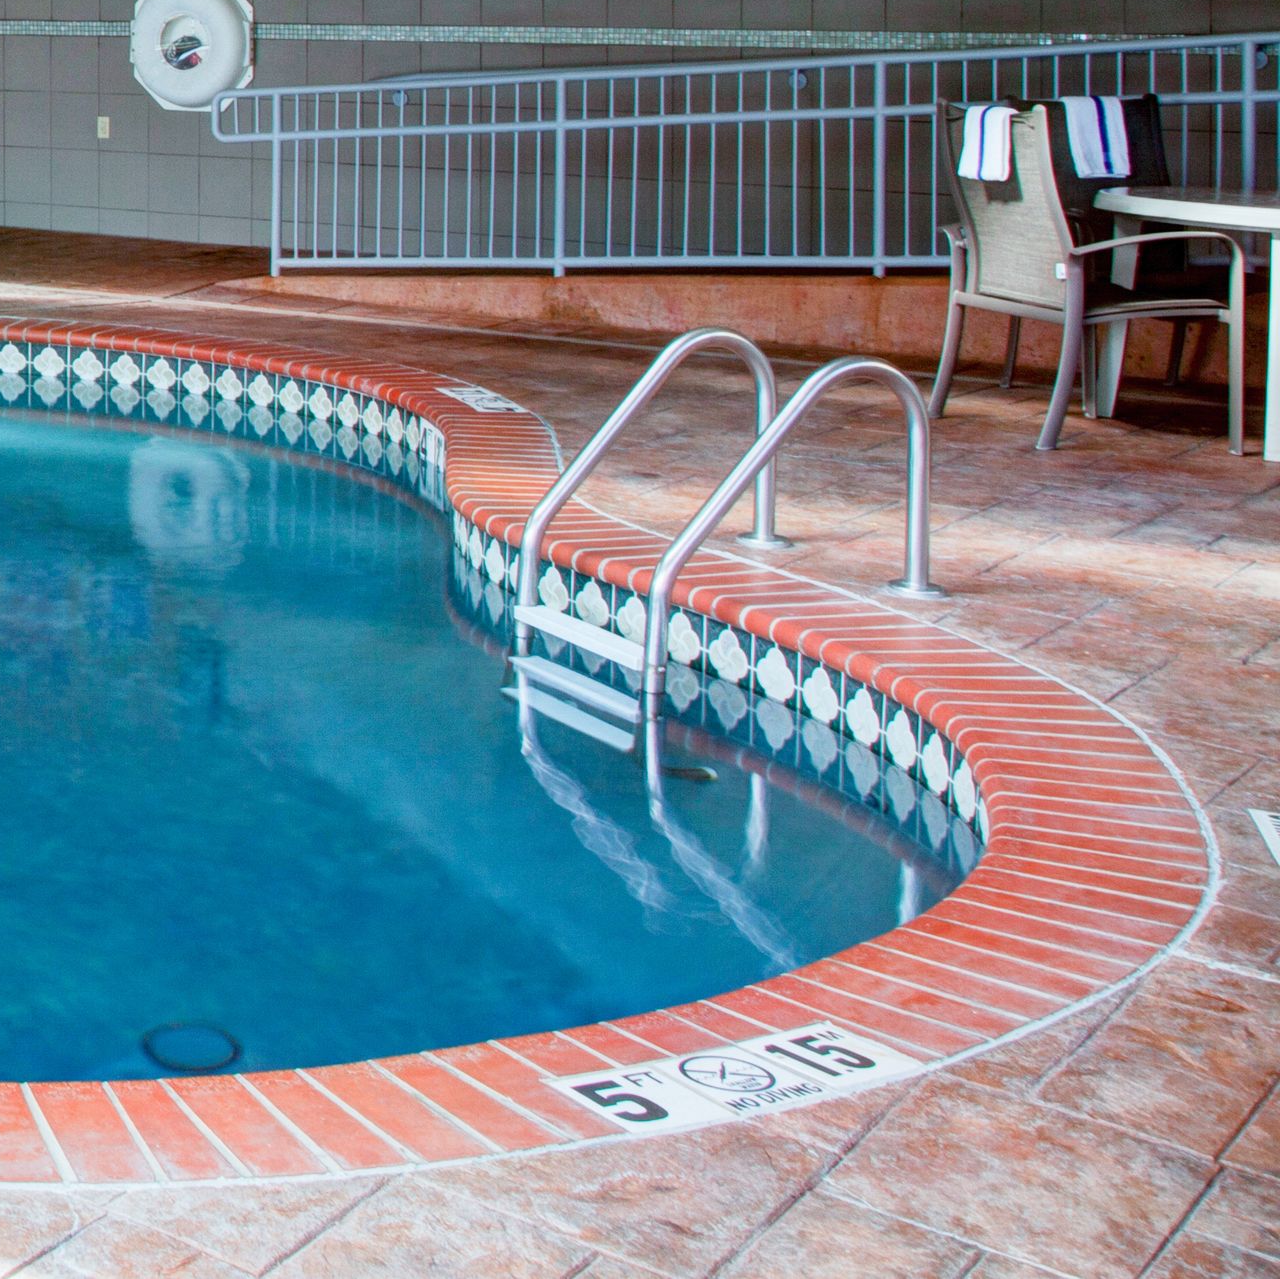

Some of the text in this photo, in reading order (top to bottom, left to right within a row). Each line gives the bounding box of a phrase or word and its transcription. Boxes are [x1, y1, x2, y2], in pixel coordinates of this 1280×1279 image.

[570, 1071, 669, 1122] 5 FT
[724, 1096, 761, 1112] NO
[755, 1083, 822, 1104] DIVING
